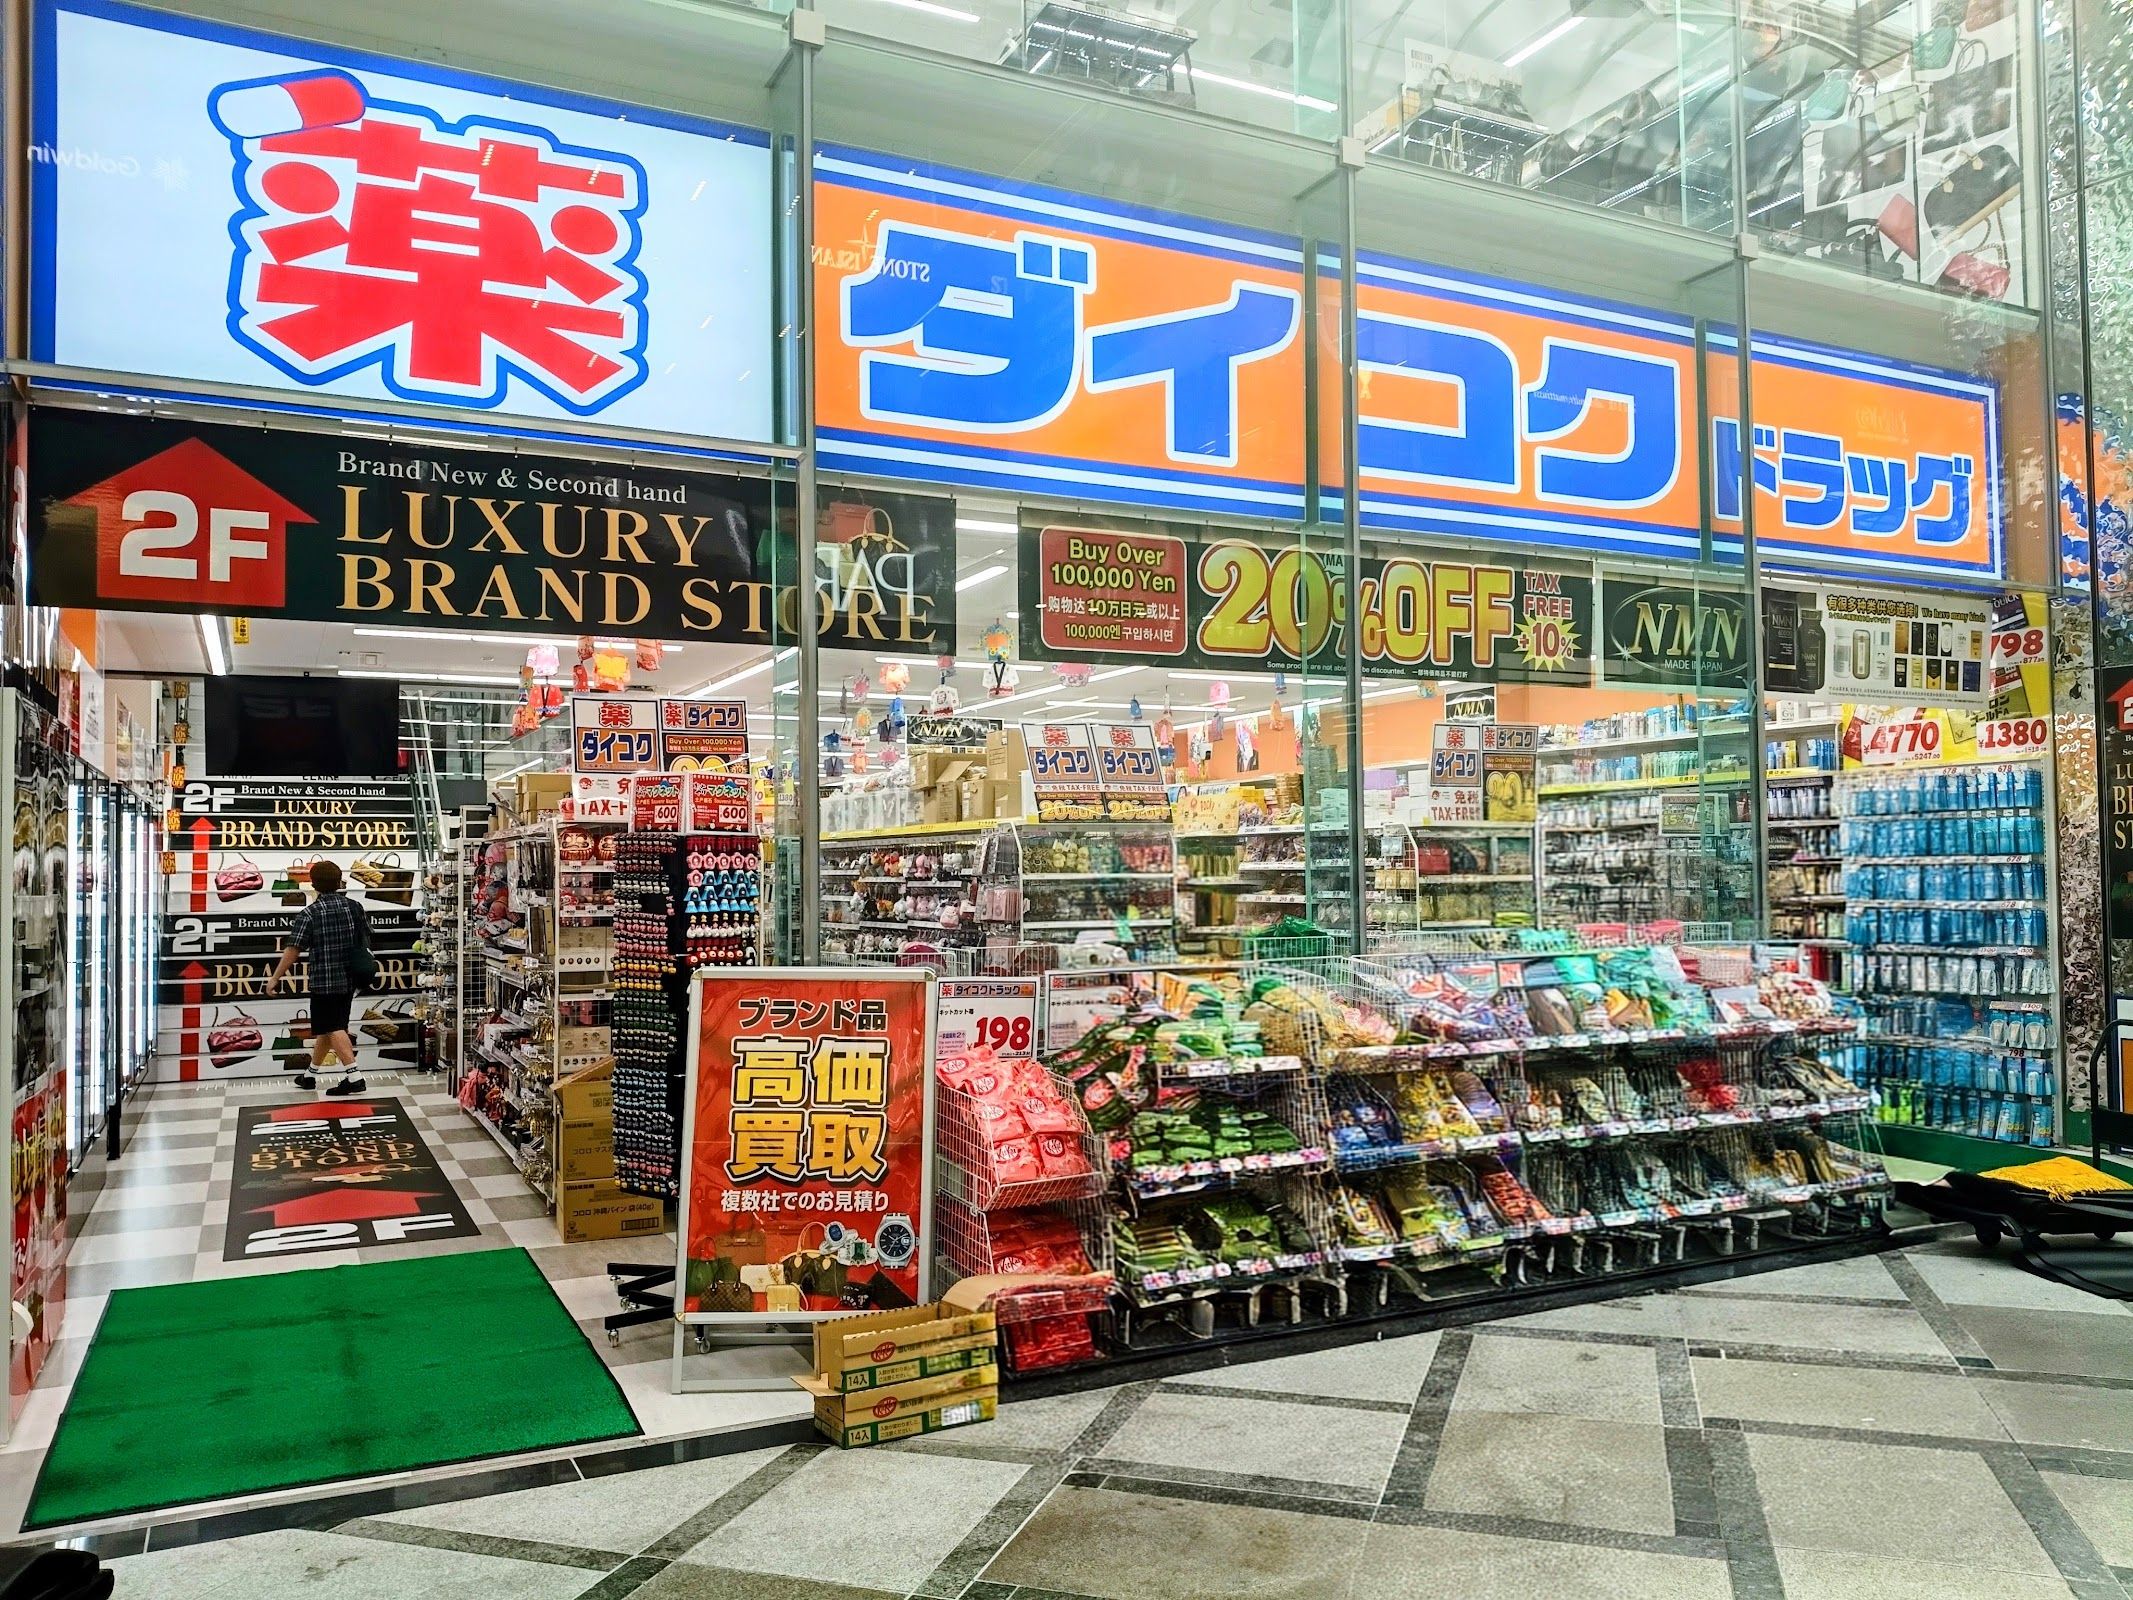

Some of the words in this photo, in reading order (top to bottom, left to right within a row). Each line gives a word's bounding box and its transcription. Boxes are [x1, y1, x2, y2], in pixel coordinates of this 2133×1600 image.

[207, 68, 649, 416] 薬
[840, 218, 1682, 509] ダイコク
[1712, 415, 1974, 547] ドラッグ
[338, 451, 421, 480] Brand
[430, 462, 488, 487] New
[497, 467, 518, 489] &
[528, 470, 618, 498] Second
[627, 479, 687, 504] hand
[120, 489, 270, 583] 2F
[336, 485, 713, 568] LUXURY
[1069, 538, 1110, 564] Buy
[1116, 542, 1165, 566] Over
[1051, 563, 1134, 589] 100,000
[1138, 570, 1176, 593] Yen
[1523, 570, 1562, 595] TAX
[335, 553, 652, 626] BRAND
[680, 577, 937, 643] STORE
[1523, 594, 1573, 620] FREE
[1518, 621, 1574, 660] +10%
[1628, 601, 1745, 661] NMN
[1266, 661, 1286, 670] Some
[1664, 659, 1690, 670] MADE
[1700, 661, 1723, 672] APAN
[599, 701, 633, 729] 薬
[664, 701, 684, 729] 薬
[687, 705, 740, 728] ダイコク
[1453, 700, 1486, 717] NMN
[917, 722, 963, 738] NMN
[1497, 729, 1533, 748] ダイコク
[581, 730, 654, 764] ダイコク
[1035, 750, 1090, 775] ダイコク
[1103, 750, 1155, 775] ダイコク
[1434, 750, 1478, 778] ダイコク
[182, 783, 236, 812] 2F
[241, 785, 275, 796] Brand
[278, 785, 302, 796] New
[305, 786, 314, 796] &
[318, 786, 357, 797] Second
[360, 786, 386, 797] hand
[273, 799, 356, 816] LUXURY
[657, 806, 677, 819] 600
[722, 807, 747, 820] 600
[219, 820, 315, 849] BRAND
[321, 820, 410, 848] STORE
[172, 917, 232, 953] 2F
[238, 917, 276, 928] Brand
[738, 997, 889, 1031] ブランド品
[731, 1035, 891, 1108] 高価
[726, 1108, 888, 1183] 買取
[573, 1208, 592, 1217] コロロ
[721, 1189, 890, 1213] 複数社でのお見積り
[244, 1212, 456, 1254] 2F
[848, 1374, 868, 1387] 14入
[850, 1430, 870, 1443] 14入
